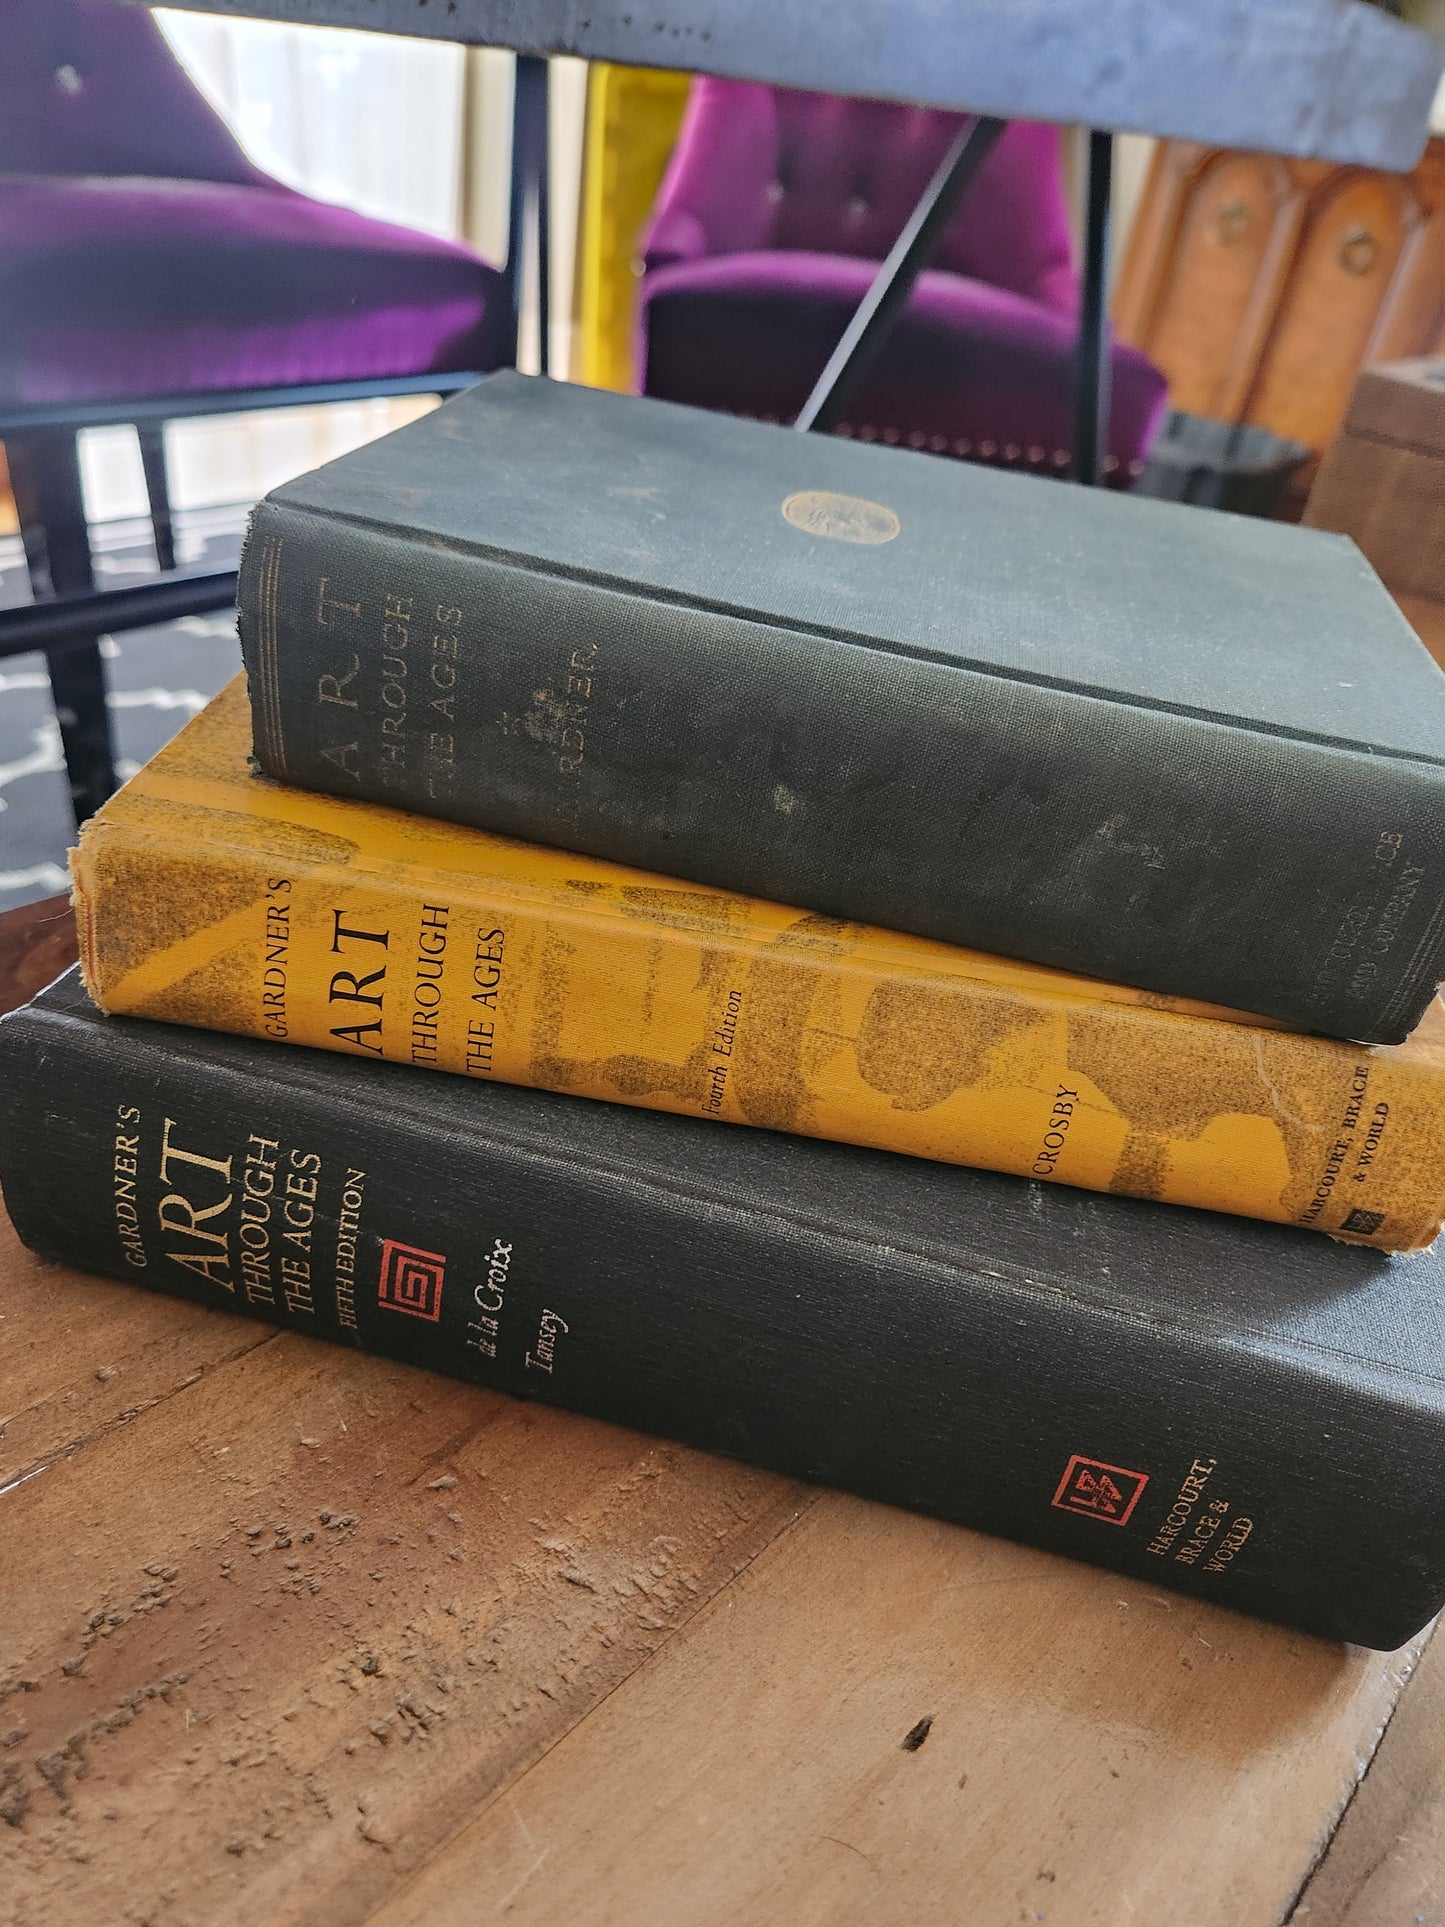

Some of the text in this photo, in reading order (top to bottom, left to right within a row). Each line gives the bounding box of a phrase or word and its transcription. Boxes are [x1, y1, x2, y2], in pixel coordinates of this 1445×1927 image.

[317, 577, 362, 783] ART
[430, 604, 463, 723] AGES
[264, 878, 292, 1038] GARDNER'S
[329, 908, 390, 1056] ART
[412, 903, 450, 1063] THROUGH
[466, 927, 505, 1072] THE AGES
[701, 990, 742, 1115] Fourth Edition
[113, 1104, 148, 1268] GARDNER'S
[1032, 1083, 1078, 1175] CROSBY
[1301, 1065, 1369, 1224] HARCOURT, BRACE
[1353, 1173, 1367, 1183] &
[1358, 1102, 1389, 1167] WORLD
[158, 1116, 236, 1294] ART
[239, 1132, 280, 1305] THROUGH
[282, 1149, 322, 1314] THE AGES
[336, 1167, 367, 1330] FIFTH EDITION
[474, 1238, 513, 1312] Croix
[525, 1308, 569, 1374] Tansey
[1146, 1457, 1217, 1556] HARCOURT,
[1174, 1499, 1230, 1566] BRACE &
[1203, 1516, 1253, 1573] WORLD
